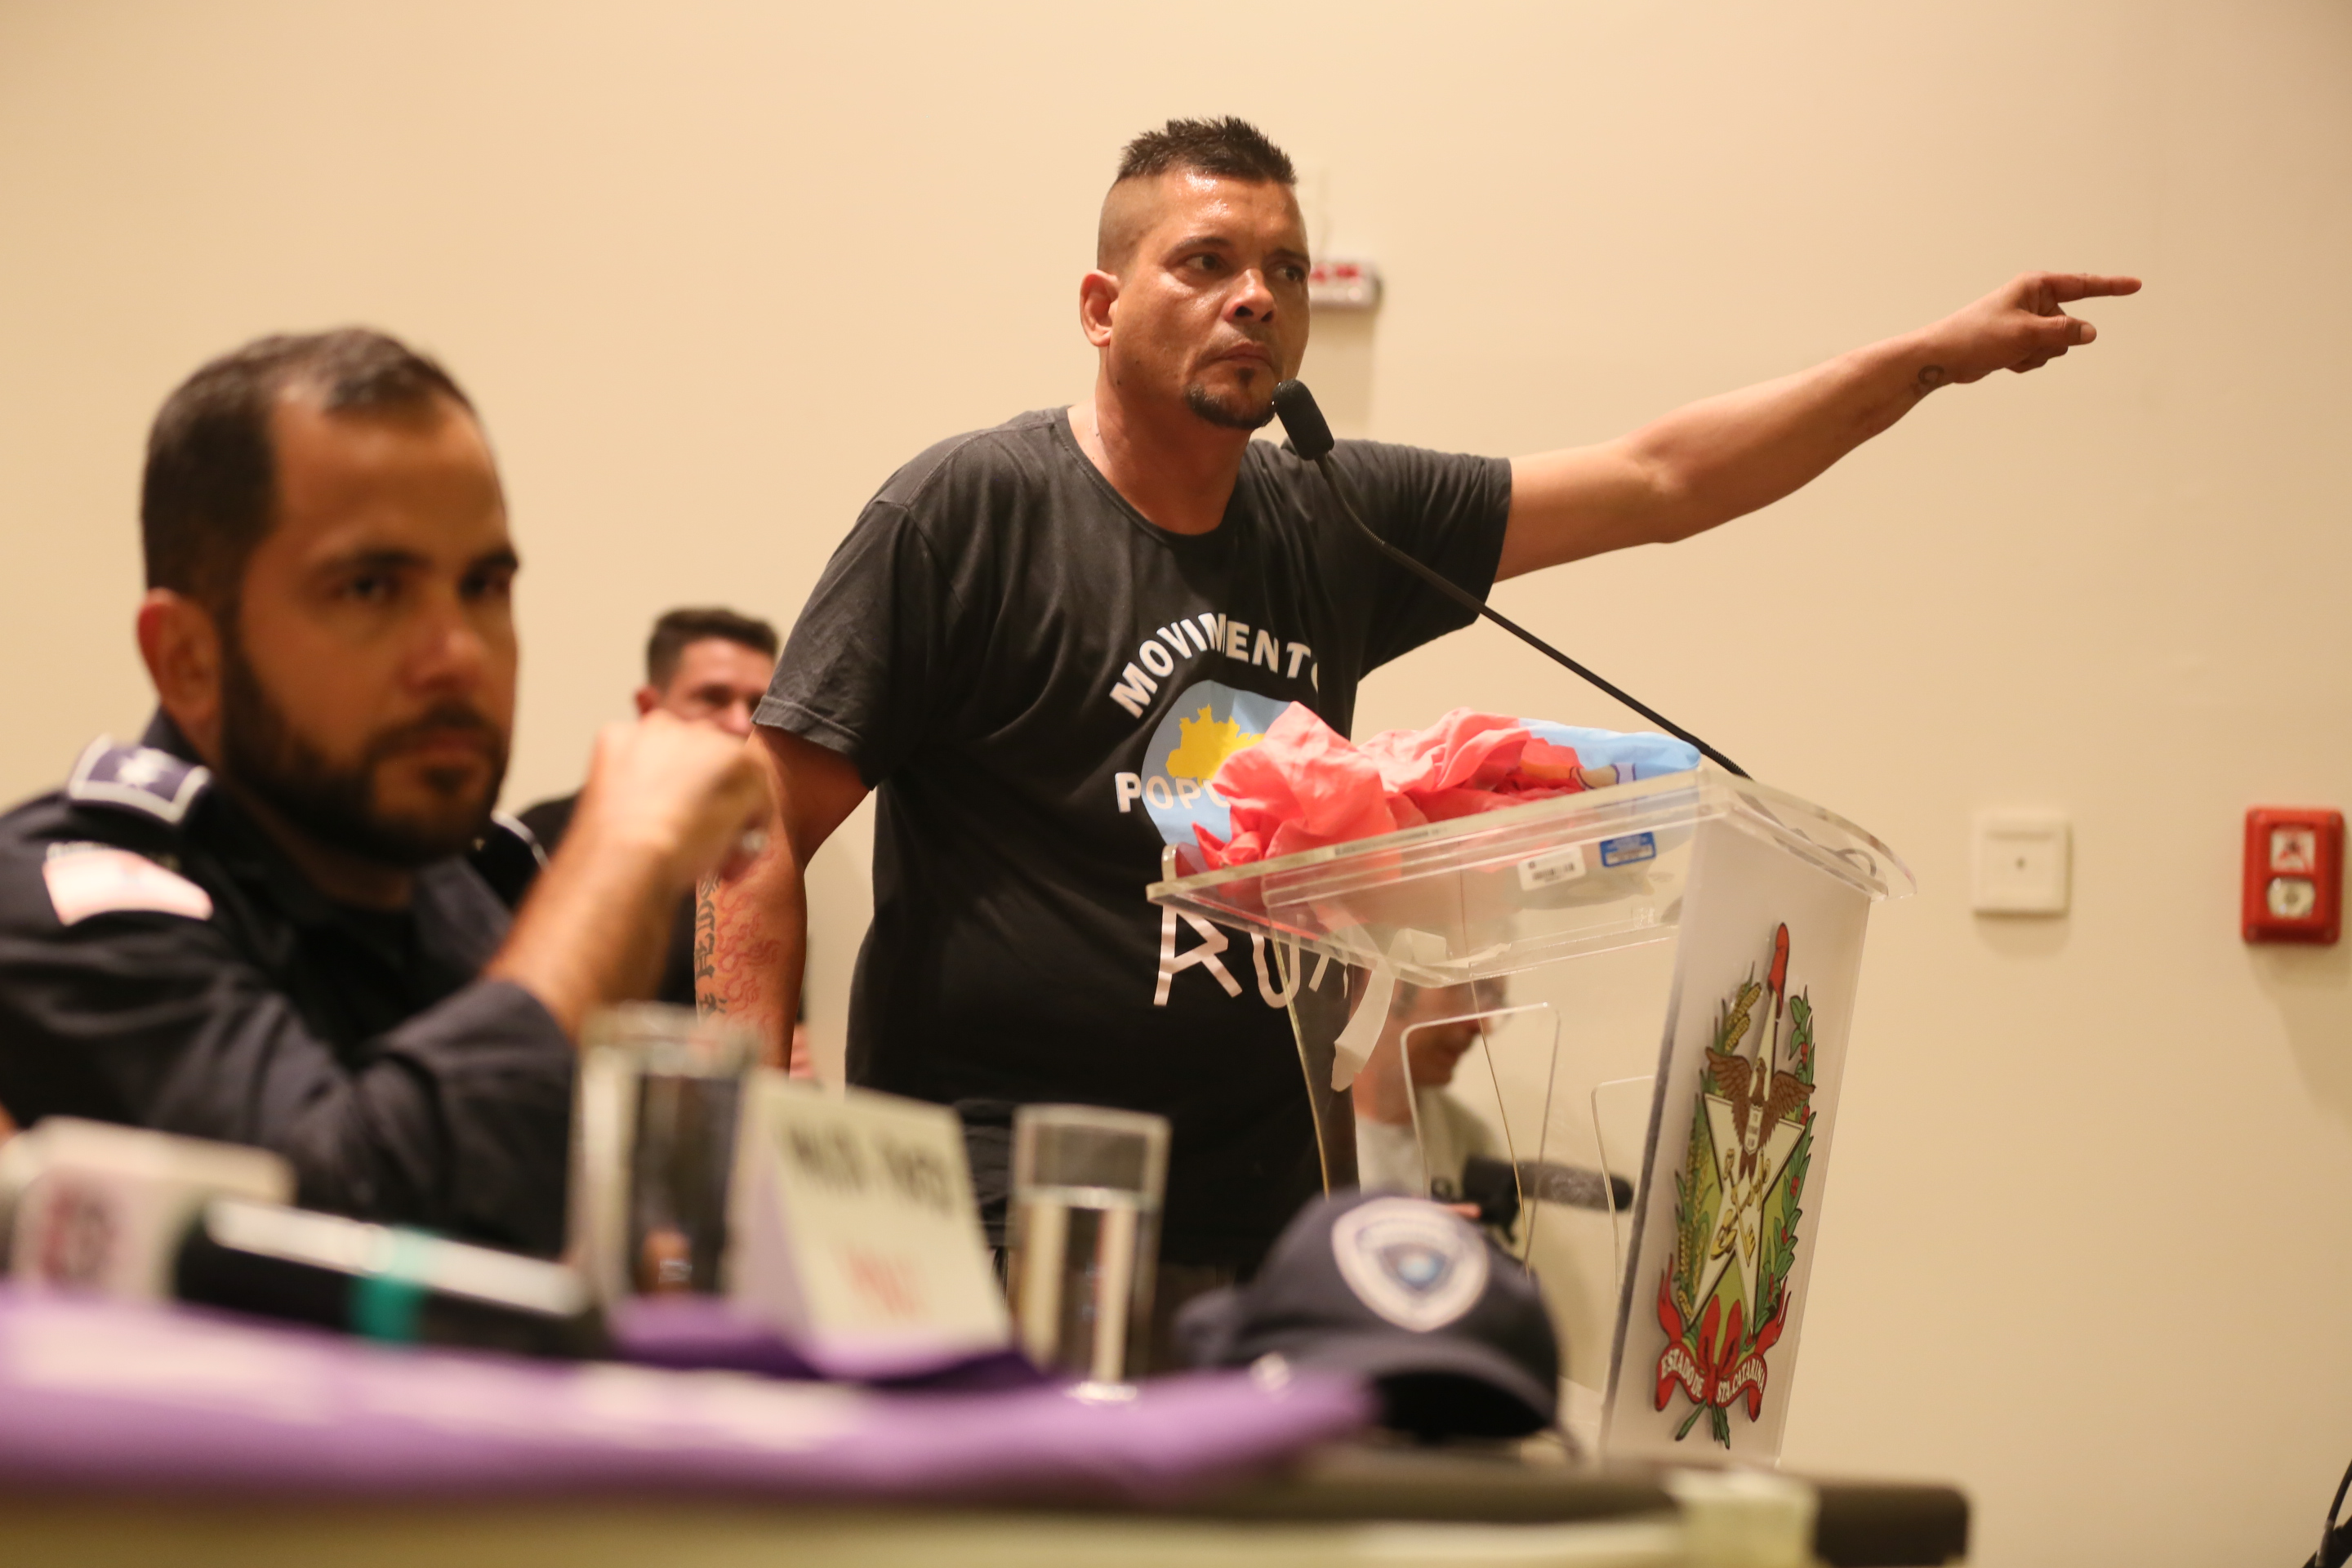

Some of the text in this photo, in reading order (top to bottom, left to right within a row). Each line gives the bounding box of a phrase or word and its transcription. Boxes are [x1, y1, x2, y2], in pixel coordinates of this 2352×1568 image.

[1660, 1348, 1695, 1387] ESTADO
[1690, 1373, 1705, 1399] DE
[1731, 1357, 1765, 1395] CATARINA
